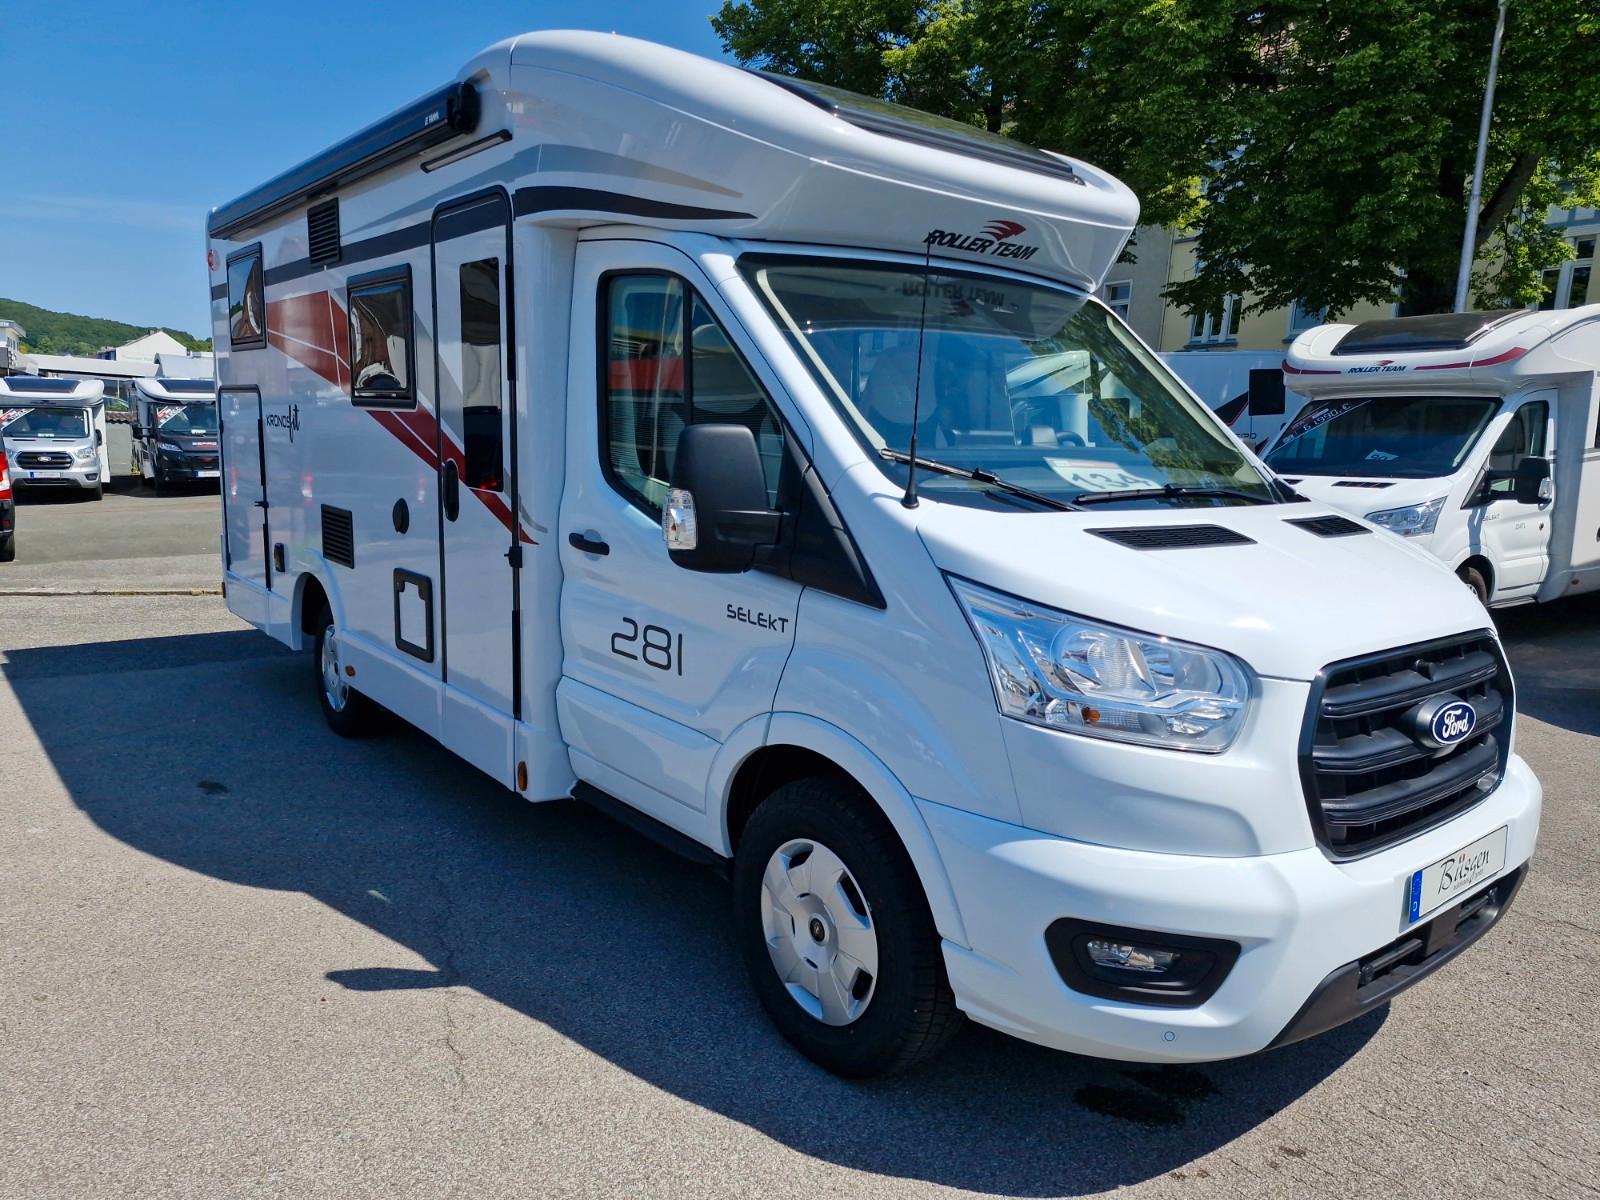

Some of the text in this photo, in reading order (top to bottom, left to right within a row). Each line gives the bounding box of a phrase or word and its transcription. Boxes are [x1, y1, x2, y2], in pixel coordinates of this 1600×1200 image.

[923, 229, 1039, 260] ROLLER TEAM
[1347, 366, 1381, 374] ROLLER
[726, 603, 789, 633] SELEKT
[611, 616, 683, 677] 281
[1442, 708, 1469, 738] Ford
[1437, 849, 1490, 895] Büsgen
